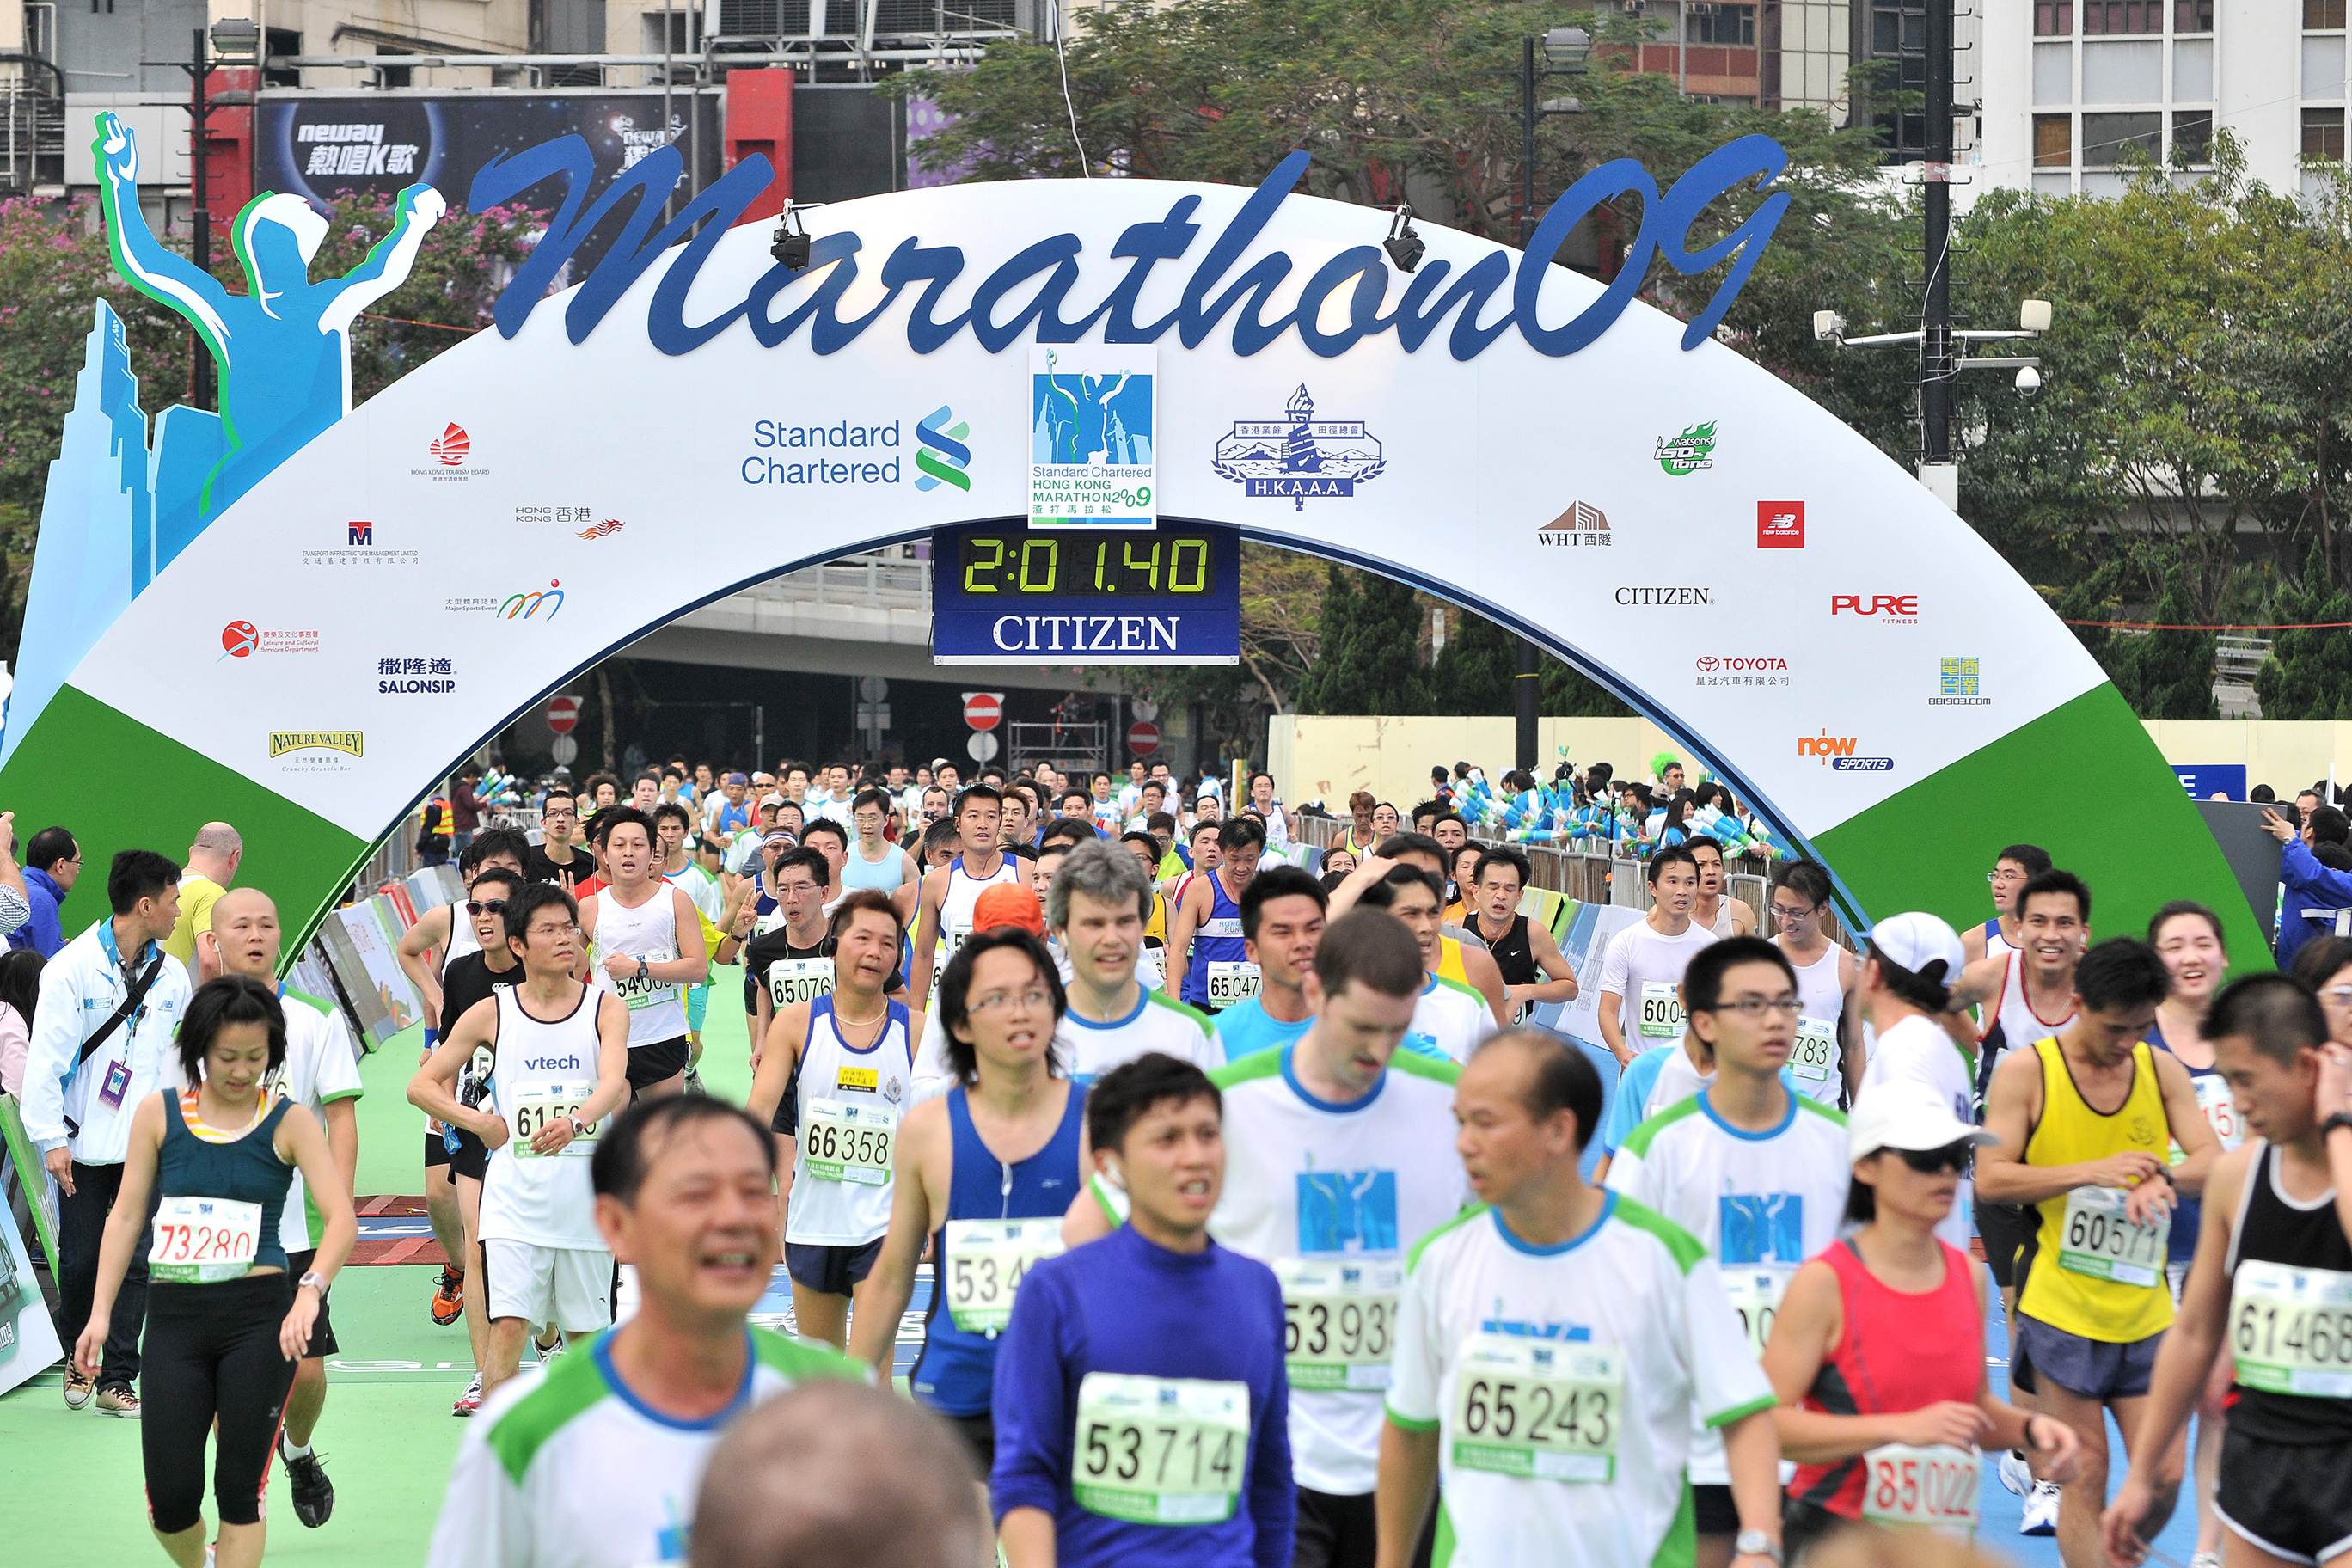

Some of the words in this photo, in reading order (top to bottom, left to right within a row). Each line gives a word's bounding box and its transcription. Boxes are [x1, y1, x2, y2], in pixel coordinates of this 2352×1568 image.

[297, 124, 384, 144] neway
[305, 144, 420, 175] 熱唱K歌
[753, 420, 900, 447] Standard
[1240, 426, 1282, 435] 香港業餘
[1318, 426, 1359, 435] 田徑總會
[1672, 438, 1712, 446] watsons
[741, 456, 900, 485] Chartered
[1032, 466, 1088, 478] Standard
[1091, 466, 1152, 478] Chartered
[1032, 480, 1070, 490] HONG
[1075, 480, 1112, 490] KONG
[1254, 481, 1344, 495] H.K.A.A.A.
[1032, 492, 1111, 503] MARATHON
[1111, 487, 1152, 507] 2009
[554, 506, 591, 523] 香港
[1032, 505, 1112, 515] 渣打馬拉松
[1538, 533, 1582, 547] WHT
[1583, 533, 1612, 547] 西隧
[1615, 587, 1710, 605] CITIZEN
[1832, 595, 1918, 616] PURE
[993, 616, 1180, 651] CITIZEN
[378, 658, 452, 675] 撒隆適
[1723, 658, 1788, 671] TOYOTA
[378, 680, 456, 694] SALONSIP
[1696, 676, 1789, 686] 皇冠汽車有限公司
[273, 733, 316, 755] NATURE
[318, 733, 360, 752] VALLEY
[1798, 737, 1857, 756] now
[1838, 758, 1889, 769] SPORTS
[1210, 977, 1259, 997] 65047
[524, 1054, 580, 1071] vtech
[808, 1124, 889, 1165] 66358
[158, 1224, 251, 1261] 73280
[1467, 1381, 1610, 1446] 65243
[1087, 1424, 1234, 1486] 53714
